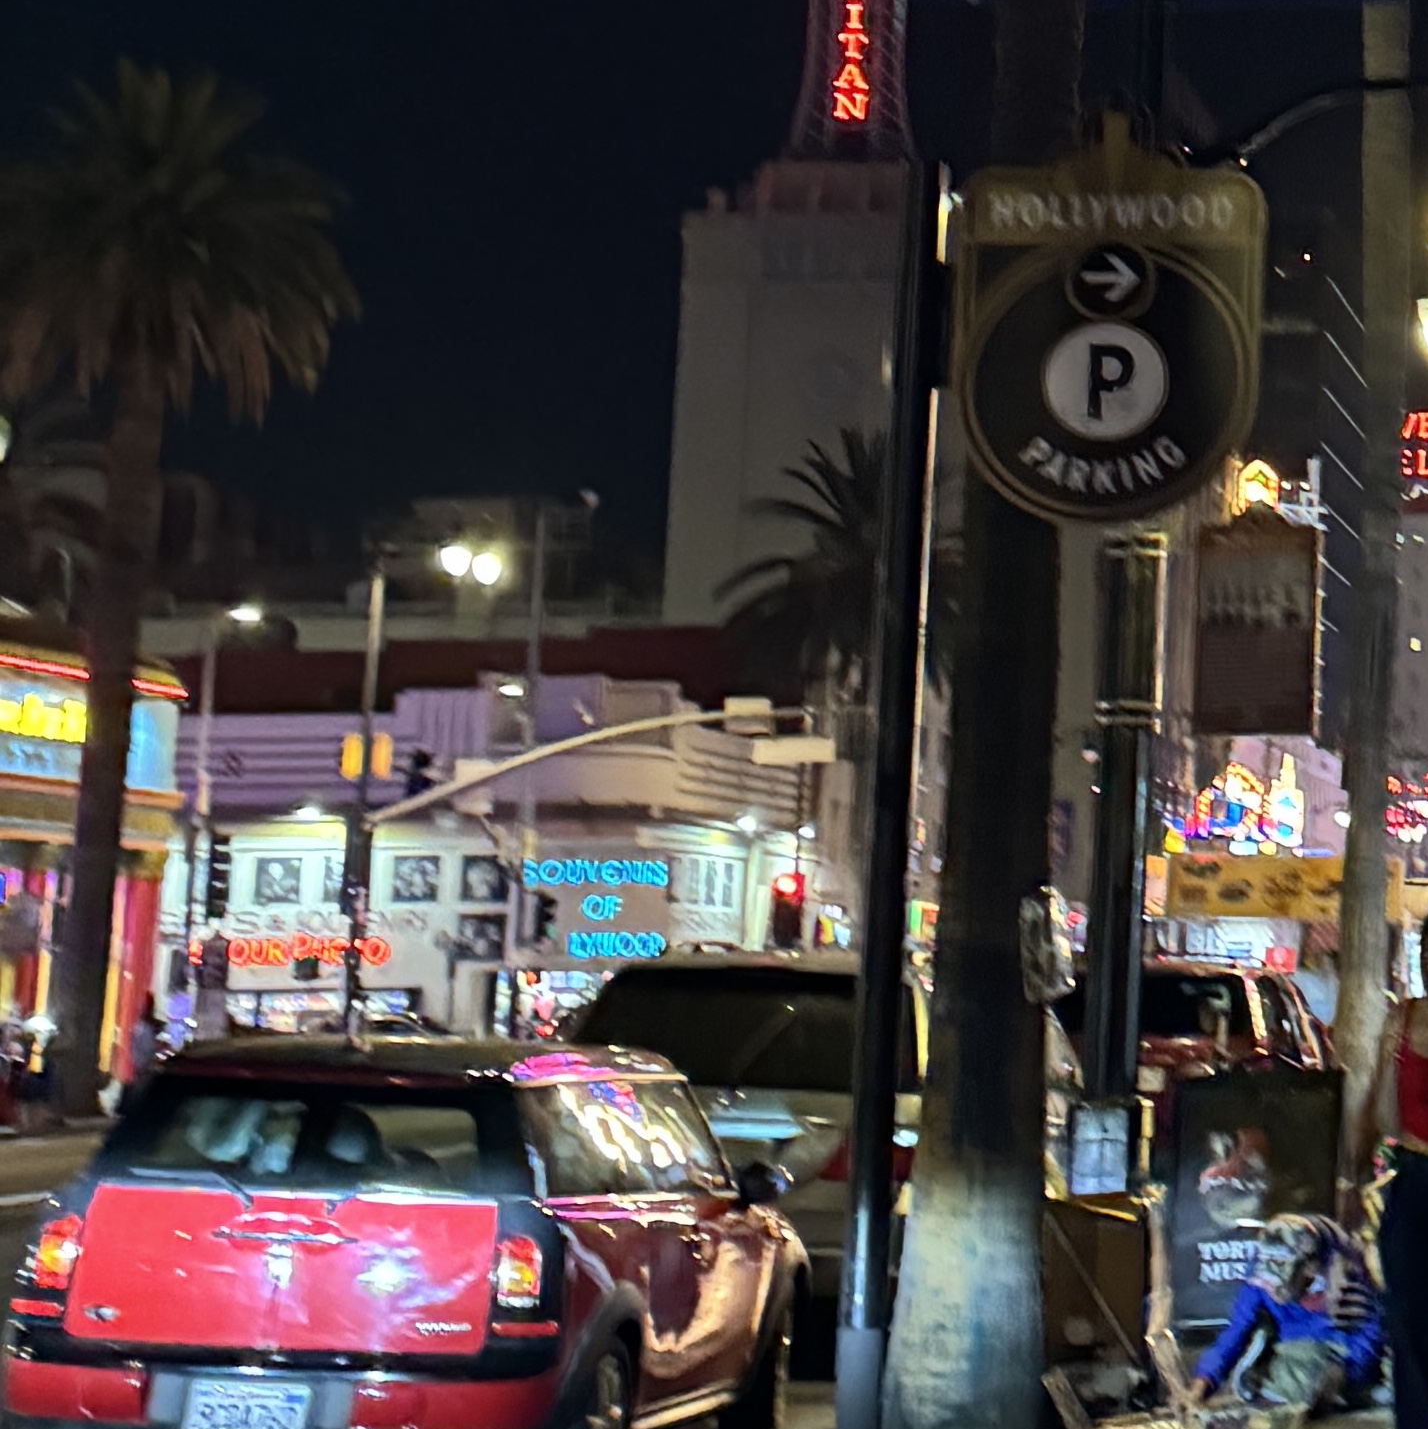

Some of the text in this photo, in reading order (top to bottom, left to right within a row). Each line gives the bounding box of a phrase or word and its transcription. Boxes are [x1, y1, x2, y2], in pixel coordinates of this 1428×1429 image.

[988, 191, 1234, 229] HOLLYWOOD
[1087, 343, 1135, 420] P
[1018, 436, 1187, 494] PARKING
[580, 894, 623, 922] OF
